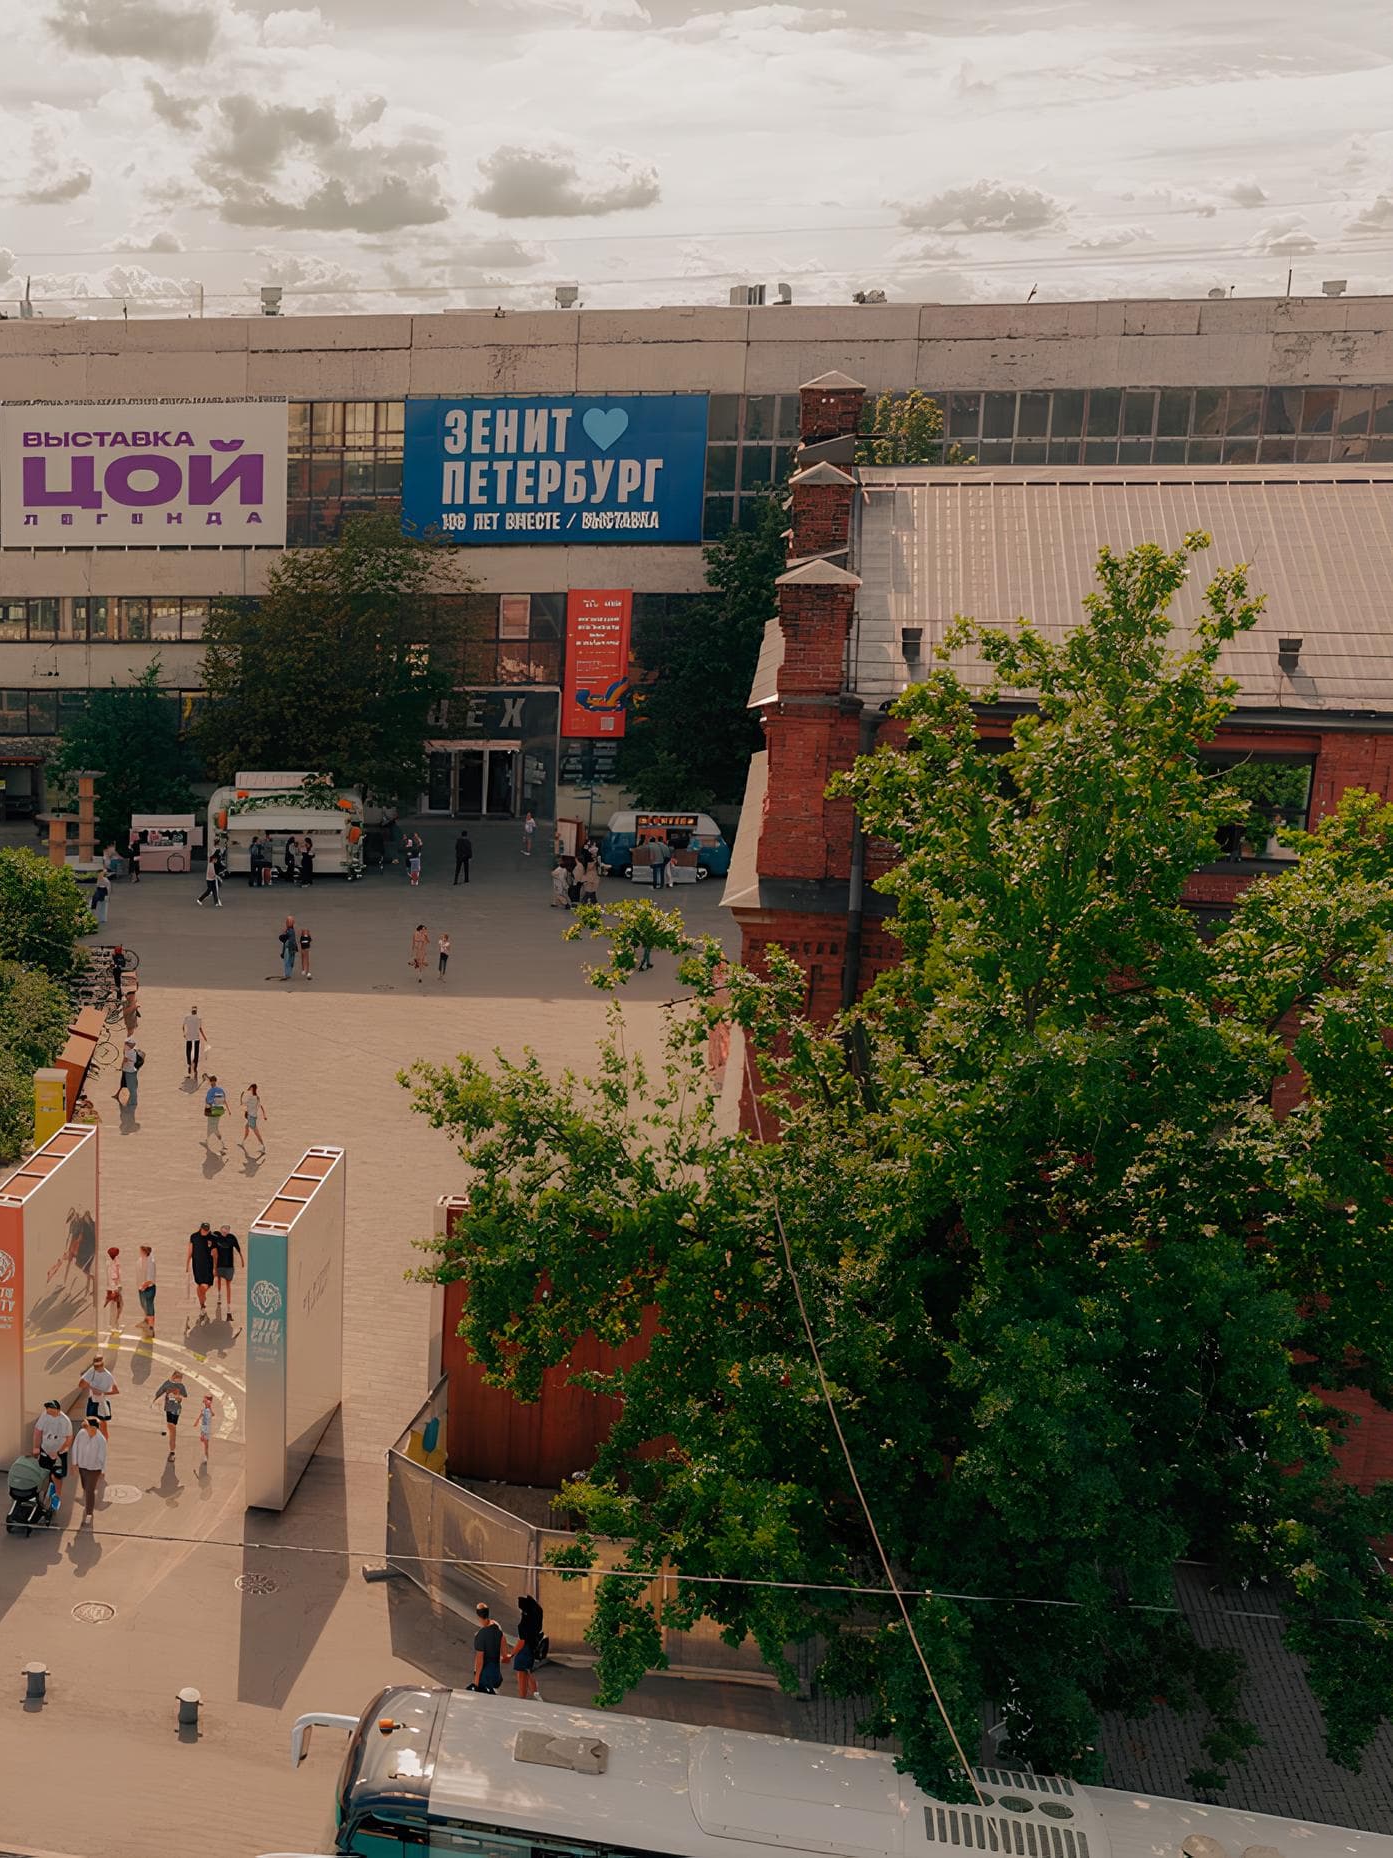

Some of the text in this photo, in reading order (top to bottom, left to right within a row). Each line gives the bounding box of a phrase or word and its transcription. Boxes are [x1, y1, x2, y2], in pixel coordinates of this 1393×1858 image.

[23, 431, 195, 448] ВЫСТАВКА
[444, 408, 573, 454] ЗЕНИТ
[23, 439, 264, 510] ЦОЙ
[441, 458, 664, 505] ПЕТЕРБУРГ
